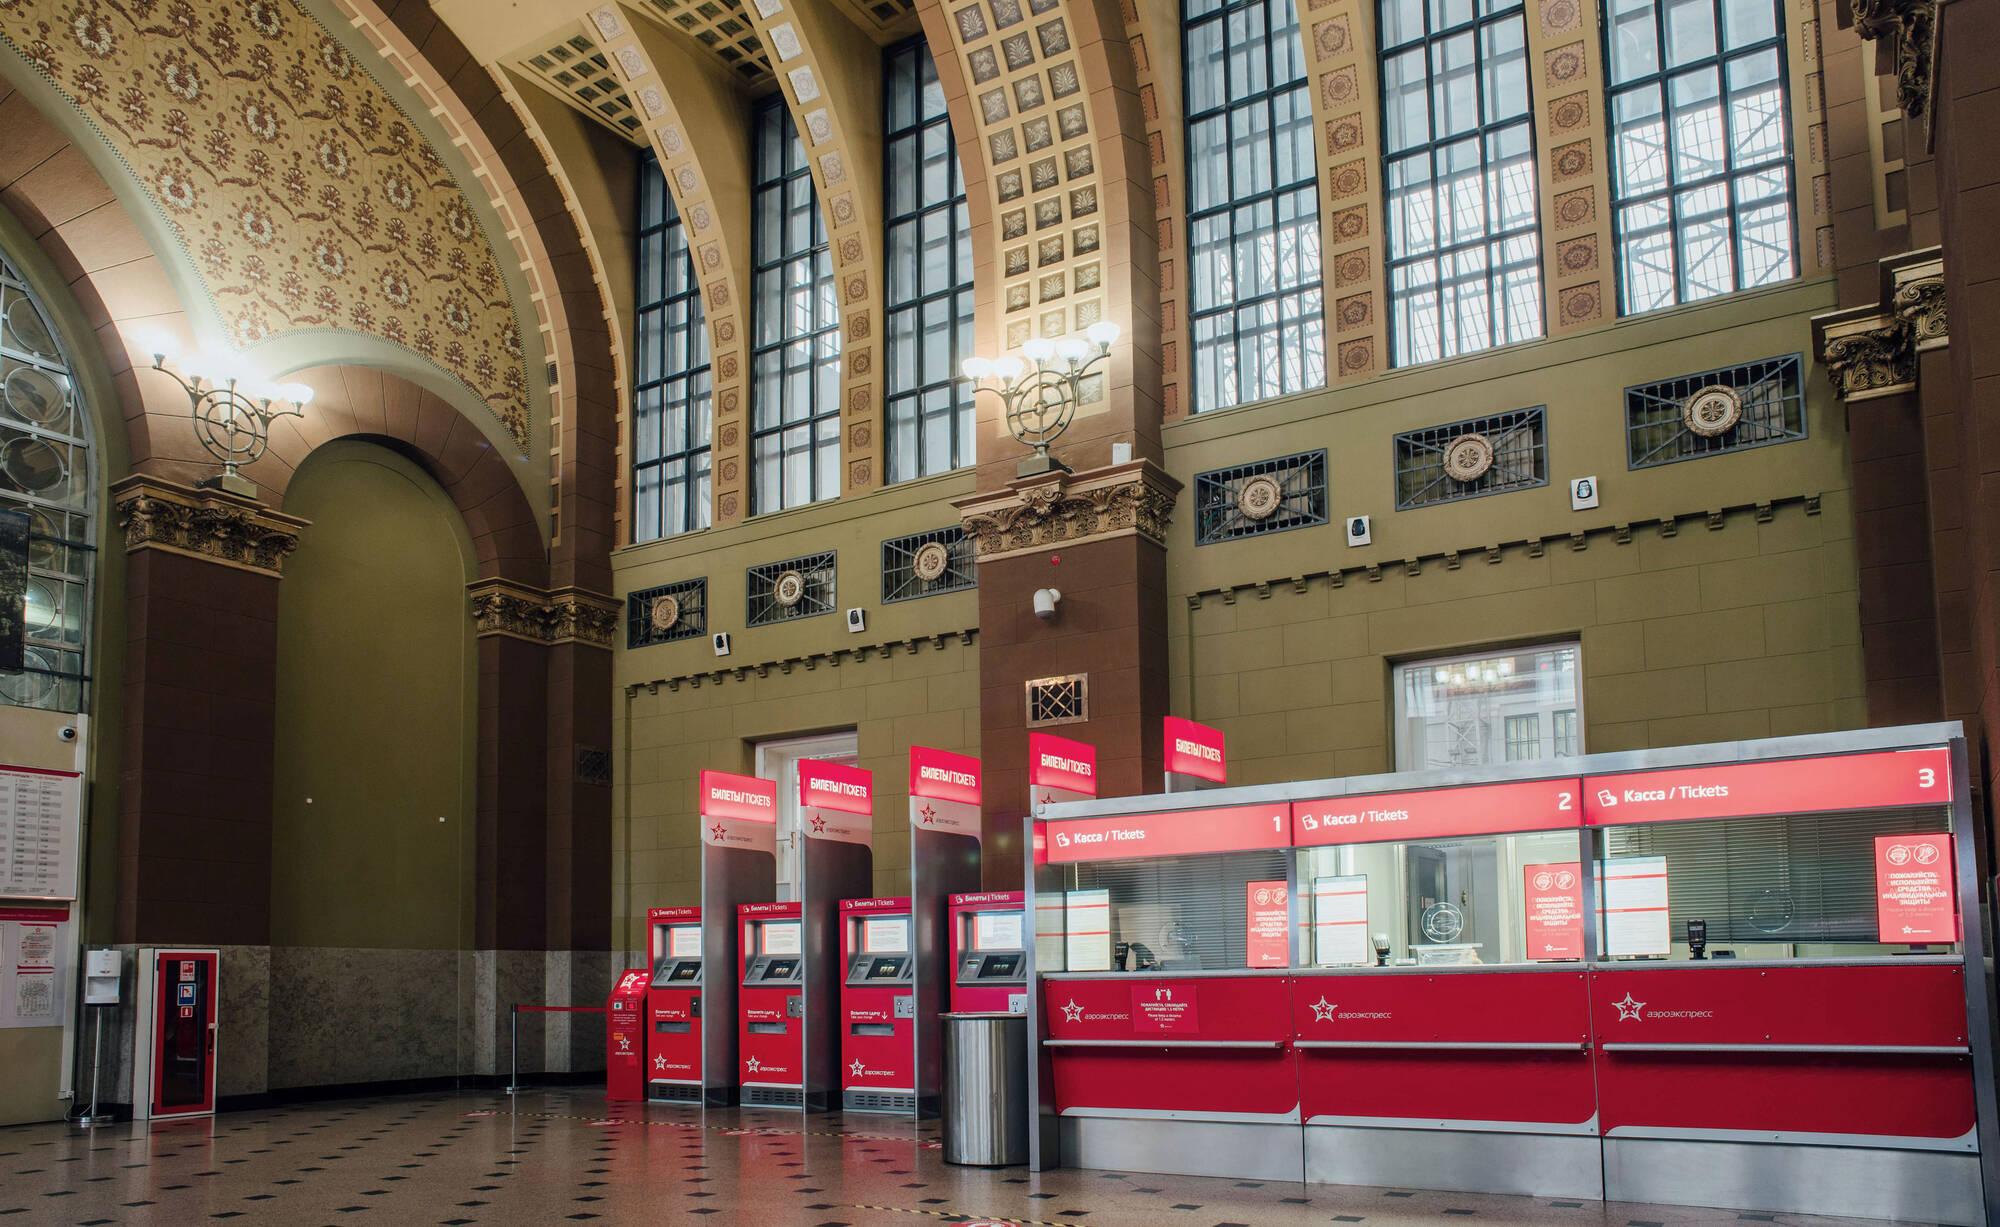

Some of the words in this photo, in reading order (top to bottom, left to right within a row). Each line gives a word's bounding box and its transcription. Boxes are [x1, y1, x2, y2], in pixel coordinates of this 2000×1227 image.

[1918, 768, 1935, 788] 3
[1558, 792, 1572, 810] 2
[1624, 789, 1666, 803] Касса
[1678, 784, 1729, 799] Tickets
[1273, 815, 1281, 832] 1
[1323, 814, 1357, 826] Касса
[1368, 809, 1409, 822] Tickets
[1074, 832, 1103, 844] Касса
[1111, 828, 1145, 841] Tickets
[991, 893, 1010, 901] Tickets
[1084, 1013, 1129, 1021] аэроэкспресс
[1338, 1012, 1392, 1020] аэроэкспресс
[1647, 1010, 1713, 1019] аэроэкспресс
